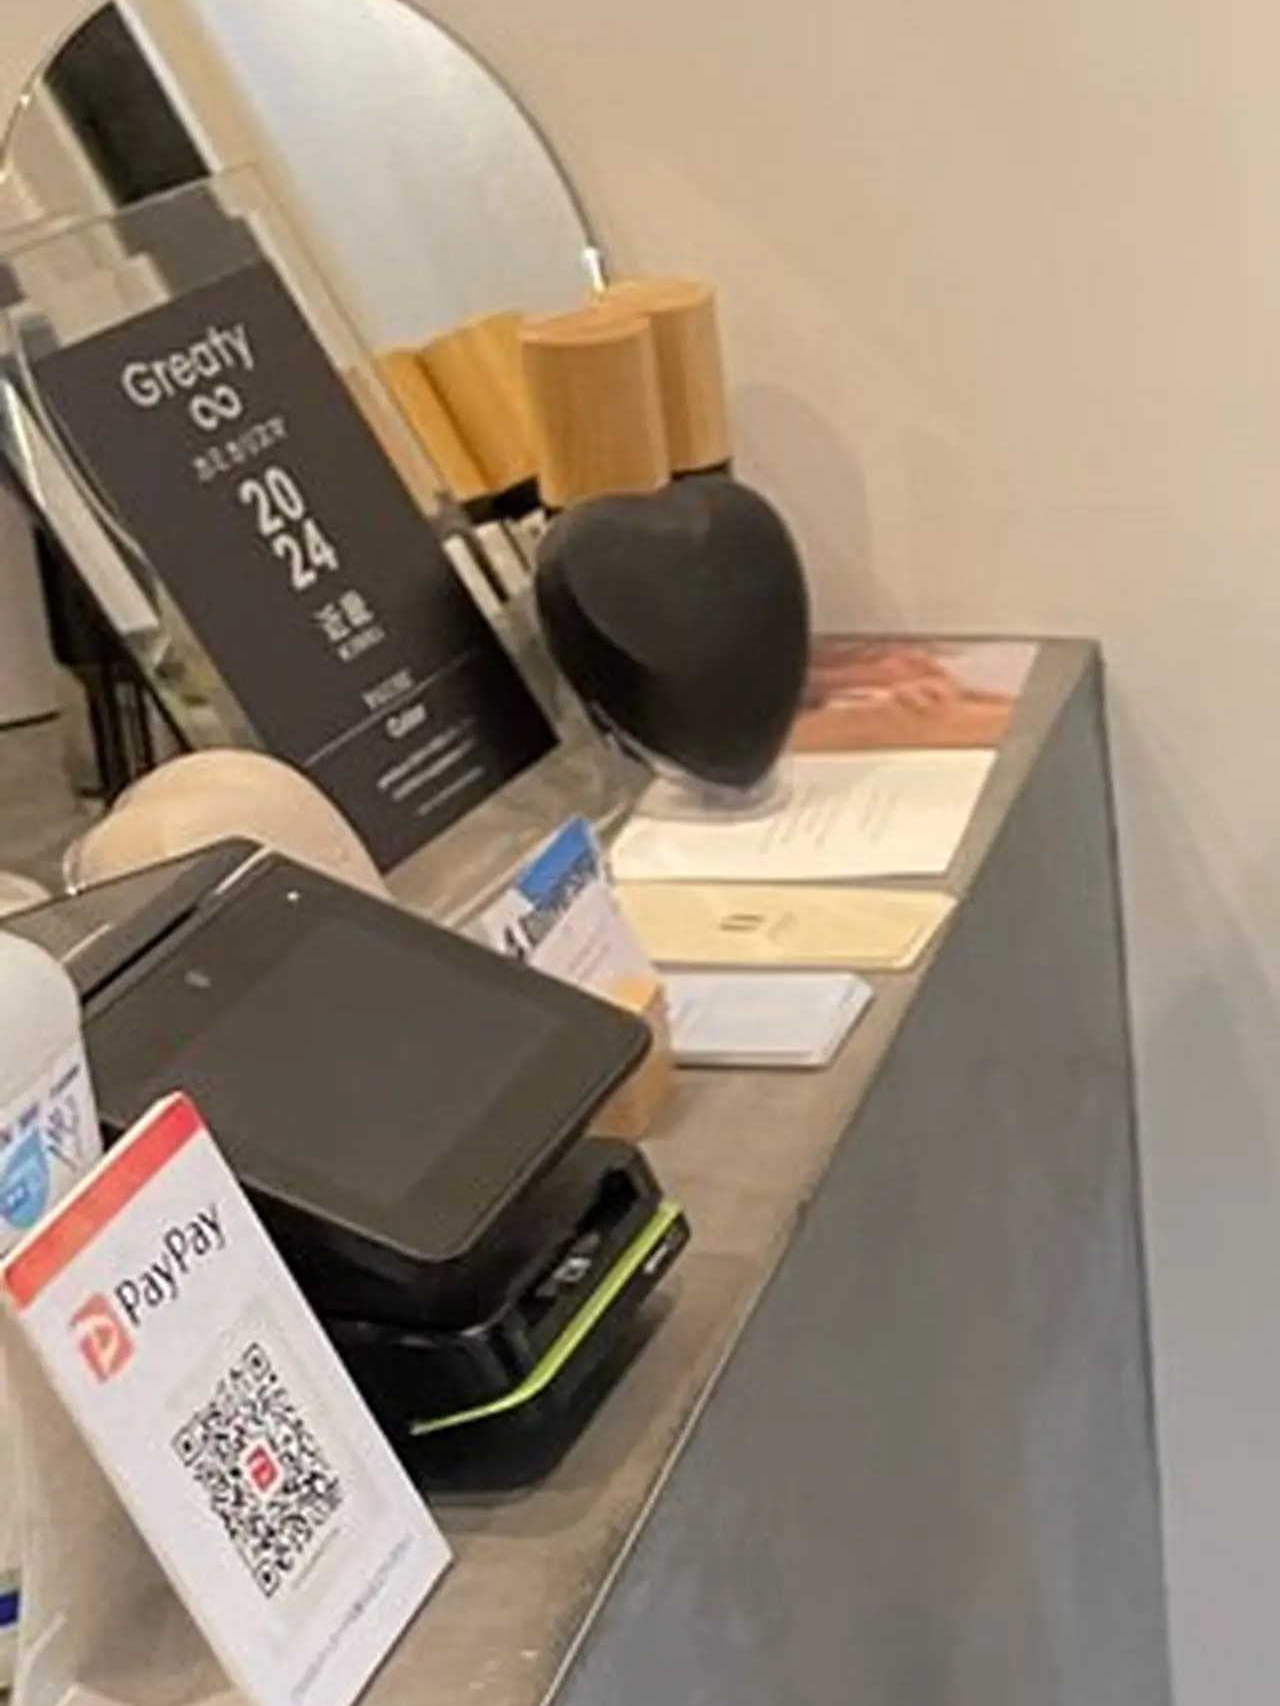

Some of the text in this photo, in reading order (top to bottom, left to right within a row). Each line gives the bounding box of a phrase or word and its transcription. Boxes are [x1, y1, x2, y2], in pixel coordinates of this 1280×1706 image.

[121, 323, 253, 408] Greaty
[239, 466, 304, 536] 20
[273, 518, 339, 590] 24
[114, 1202, 226, 1326] PayPay
